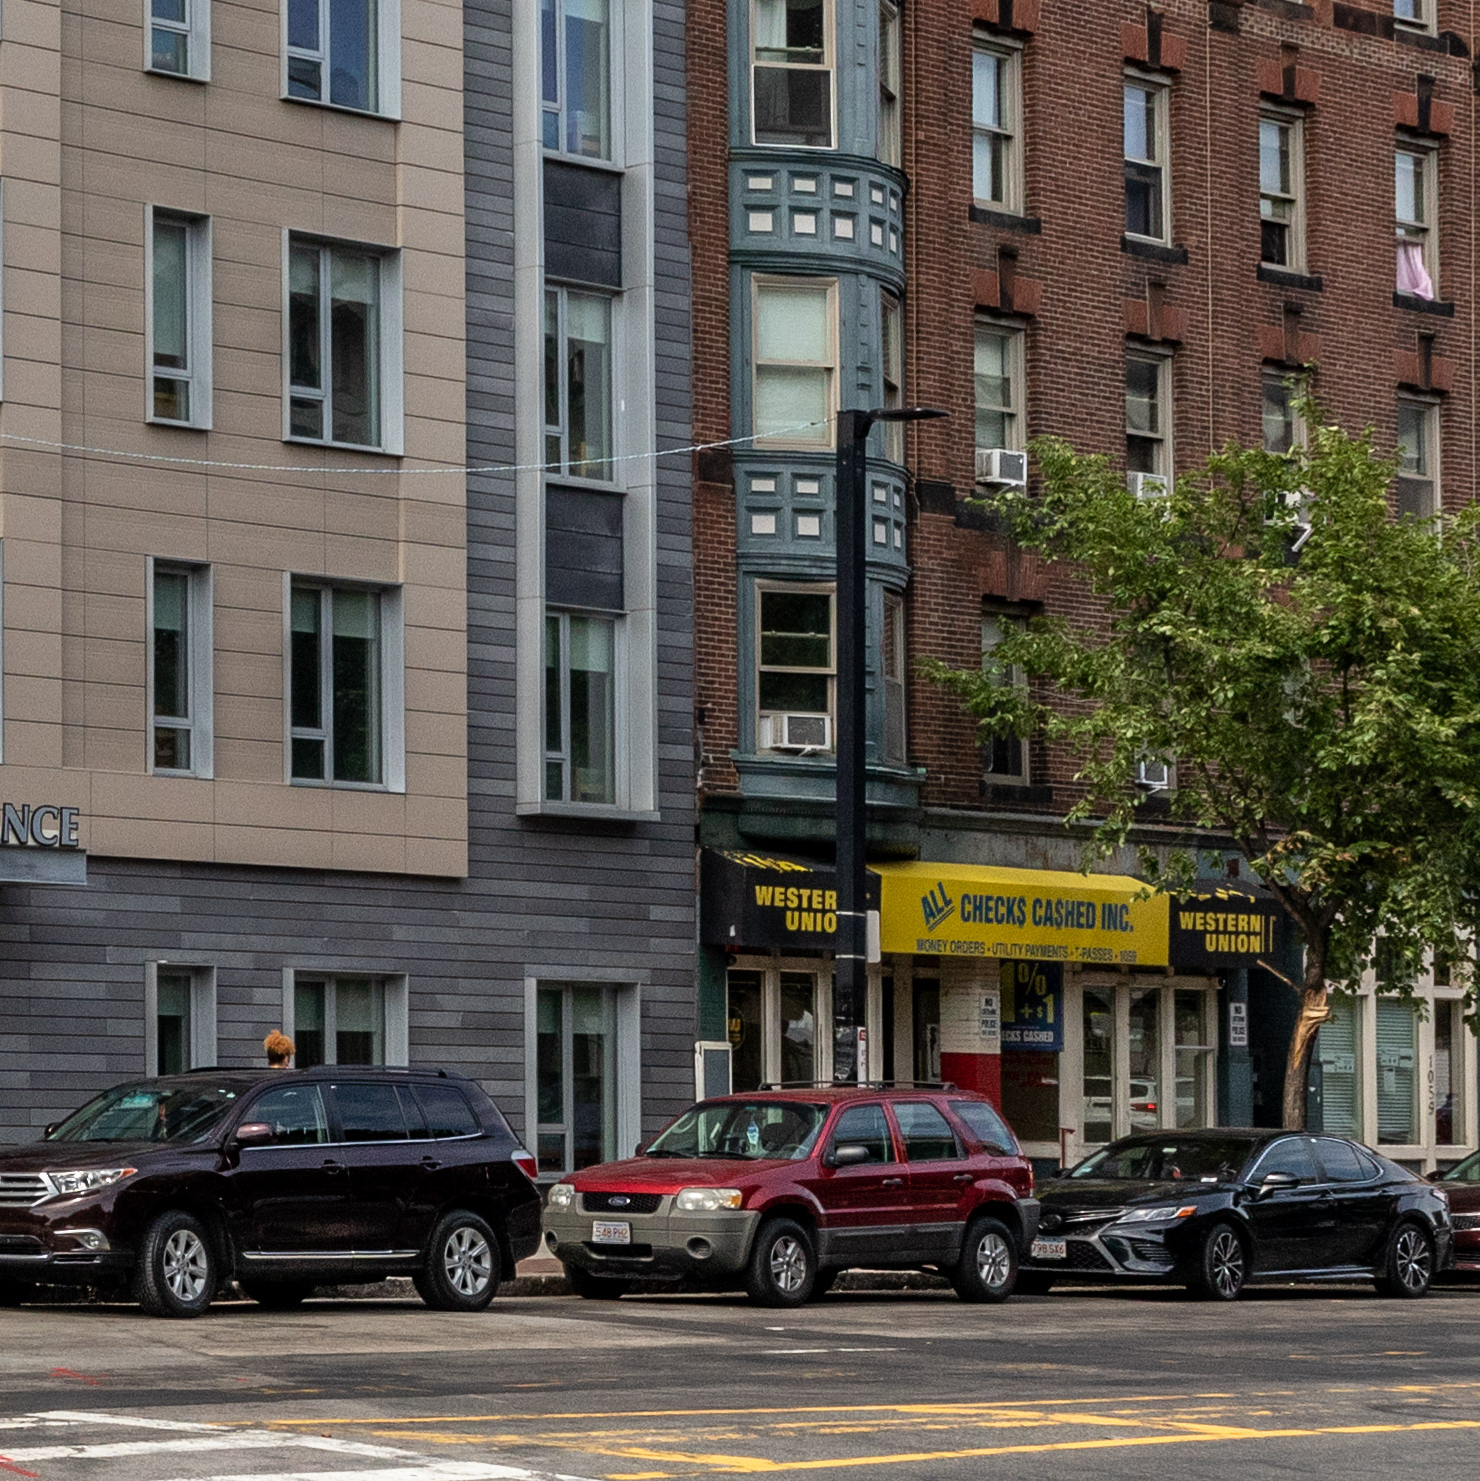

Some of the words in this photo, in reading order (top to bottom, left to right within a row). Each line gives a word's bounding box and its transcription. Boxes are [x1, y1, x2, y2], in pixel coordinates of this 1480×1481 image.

[755, 885, 837, 911] WESTER
[921, 881, 954, 926] ALL
[1100, 902, 1134, 933] INC.
[785, 910, 837, 934] UNIO
[1179, 911, 1261, 932] WESTERN
[916, 939, 947, 953] MONEY
[950, 940, 985, 955] ORDERS
[992, 942, 1024, 958] UTILITY
[1025, 944, 1068, 959] PAYMENTS
[1205, 933, 1261, 953] UNION
[1001, 1031, 1022, 1041] ECKS
[1023, 1031, 1054, 1042] CASHED
